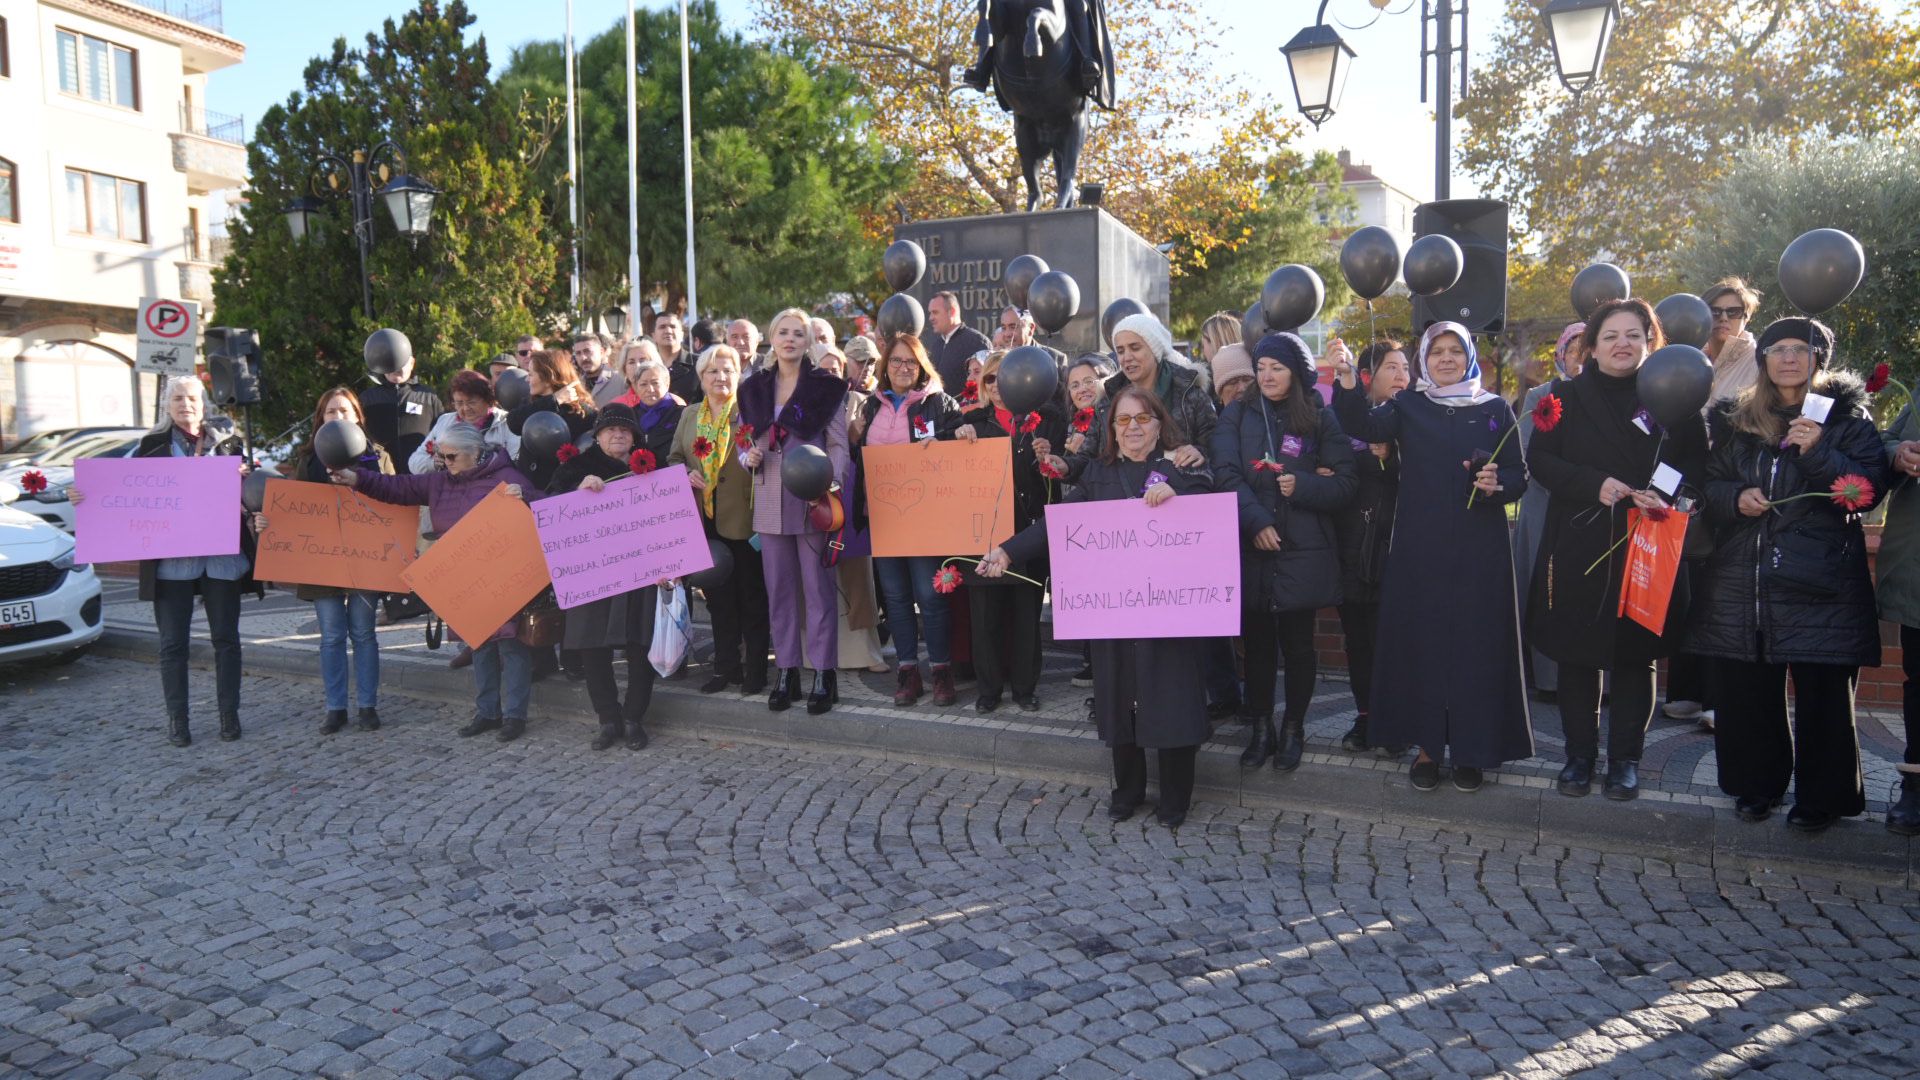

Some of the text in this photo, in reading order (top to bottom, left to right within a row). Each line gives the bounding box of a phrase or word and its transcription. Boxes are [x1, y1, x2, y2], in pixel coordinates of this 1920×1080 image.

[929, 259, 1002, 284] MUTLU
[270, 492, 330, 518] KADINA
[558, 500, 624, 523] KAHRAMAN
[623, 486, 650, 505] TÜRK
[651, 482, 680, 502] KADINI
[543, 508, 695, 554] SEN YERDE SÜRÜKLENMEYE DEĞİL
[1066, 524, 1139, 551] KADINA
[646, 537, 687, 553] GÖKLERE
[558, 580, 623, 605] YÜKSELMEYE
[2, 605, 31, 623] 645
